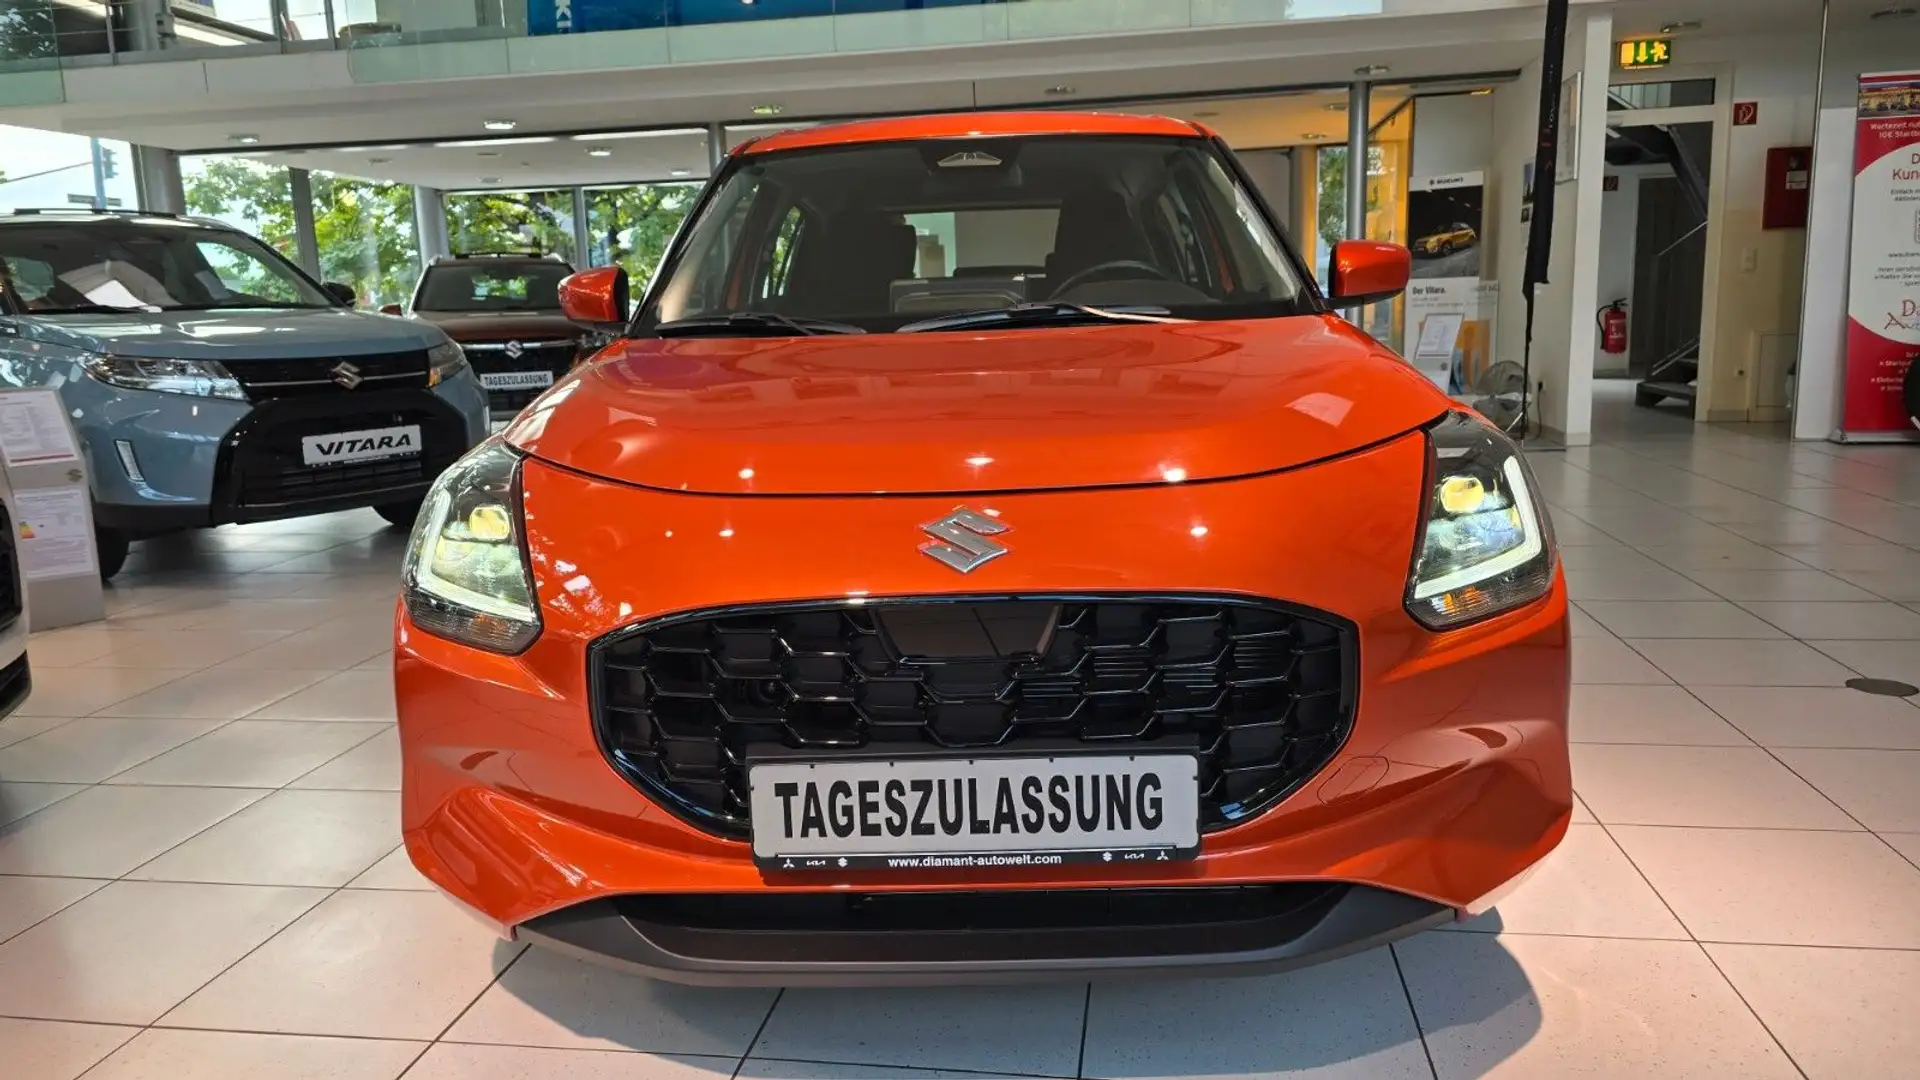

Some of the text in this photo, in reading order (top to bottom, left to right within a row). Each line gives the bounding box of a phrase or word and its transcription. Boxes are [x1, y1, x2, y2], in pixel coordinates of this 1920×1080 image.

[556, 0, 571, 28] KI
[1911, 152, 1920, 165] D
[1892, 168, 1920, 181] Kun
[484, 373, 549, 386] TAGESZULASSUNG
[315, 433, 412, 456] VITARA
[774, 772, 1164, 839] TAGESZULASSUNG
[888, 853, 1062, 869] www.diamant-autowelt.com
